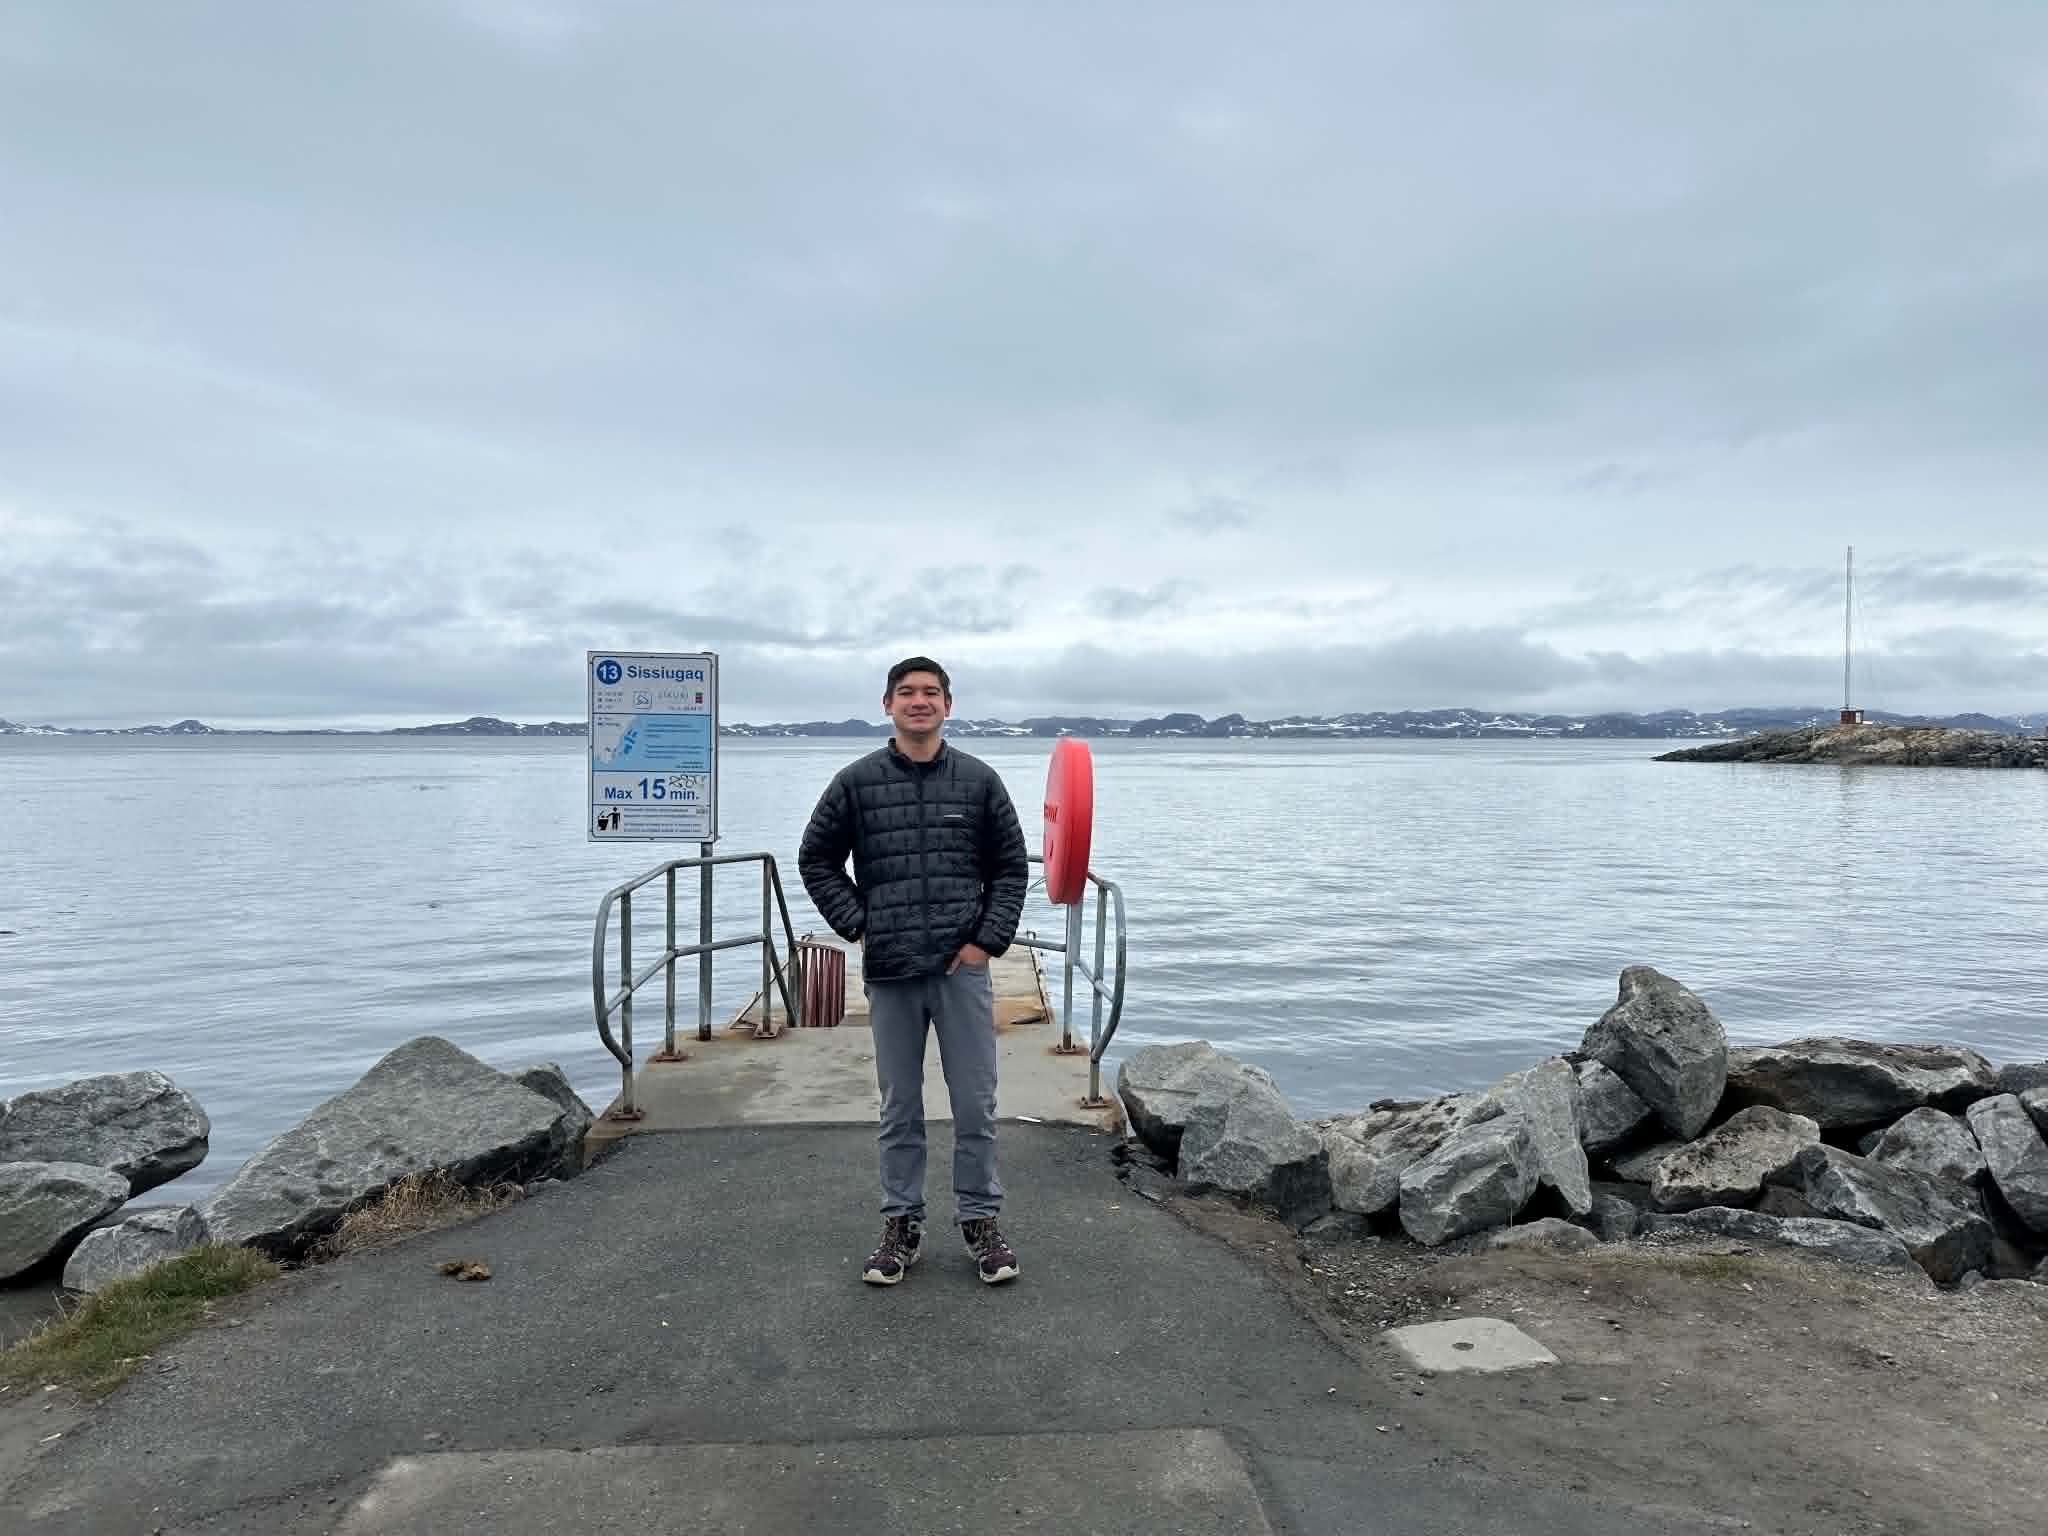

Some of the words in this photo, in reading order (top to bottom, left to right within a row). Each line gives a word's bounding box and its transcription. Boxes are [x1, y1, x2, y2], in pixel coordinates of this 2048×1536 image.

[599, 664, 618, 680] 13
[627, 665, 704, 682] Sissiugaq
[604, 787, 633, 800] Max
[638, 777, 667, 800] 15
[670, 788, 700, 800] min.
